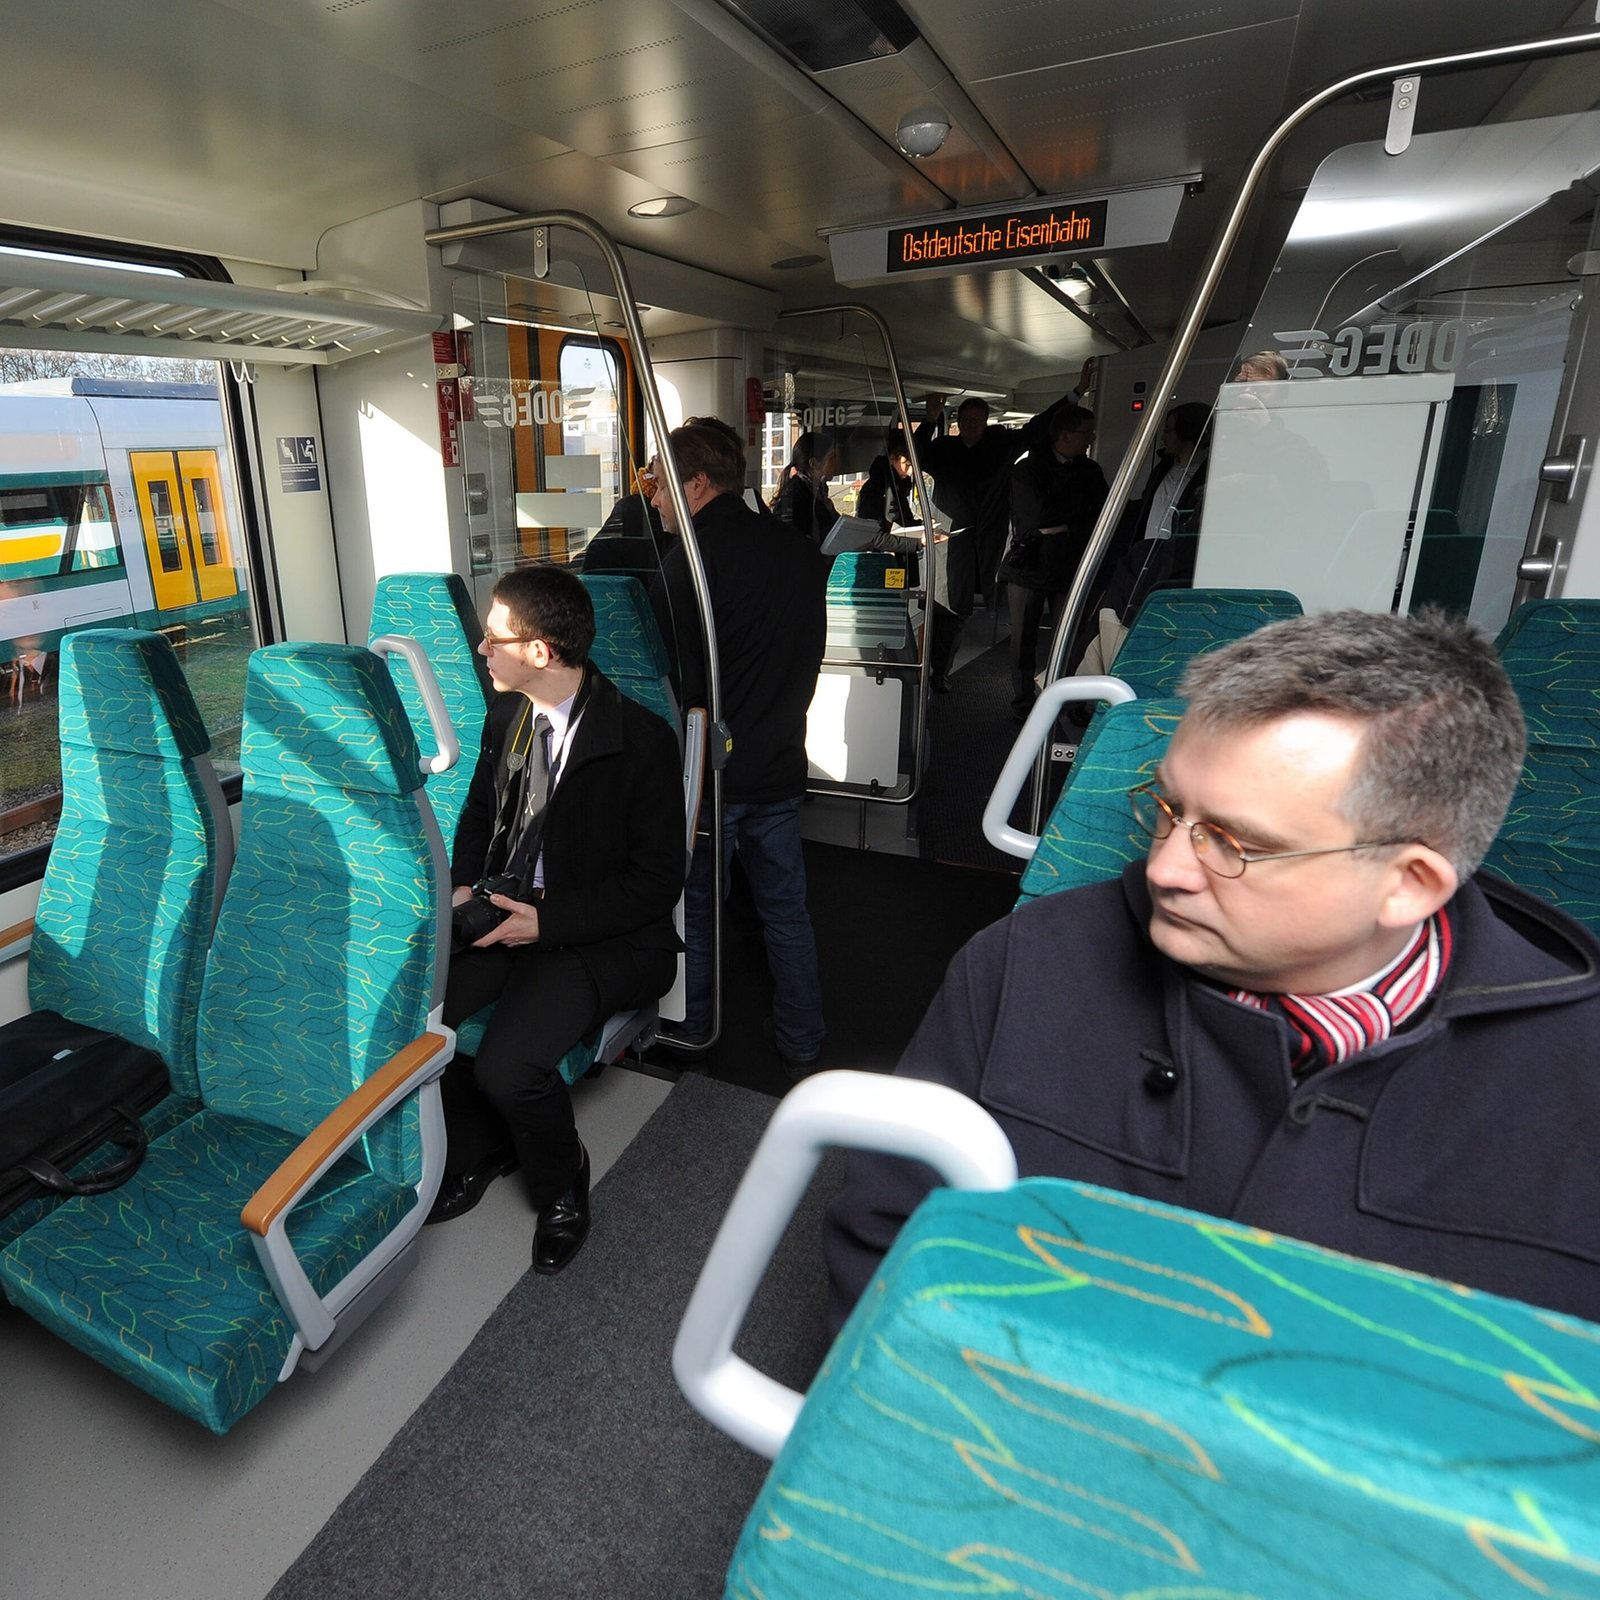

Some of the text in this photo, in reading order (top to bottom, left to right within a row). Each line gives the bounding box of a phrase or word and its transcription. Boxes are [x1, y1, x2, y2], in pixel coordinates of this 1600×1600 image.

[903, 210, 1090, 262] Ostdeutsche Eisenbahn
[803, 406, 846, 427] ODEG
